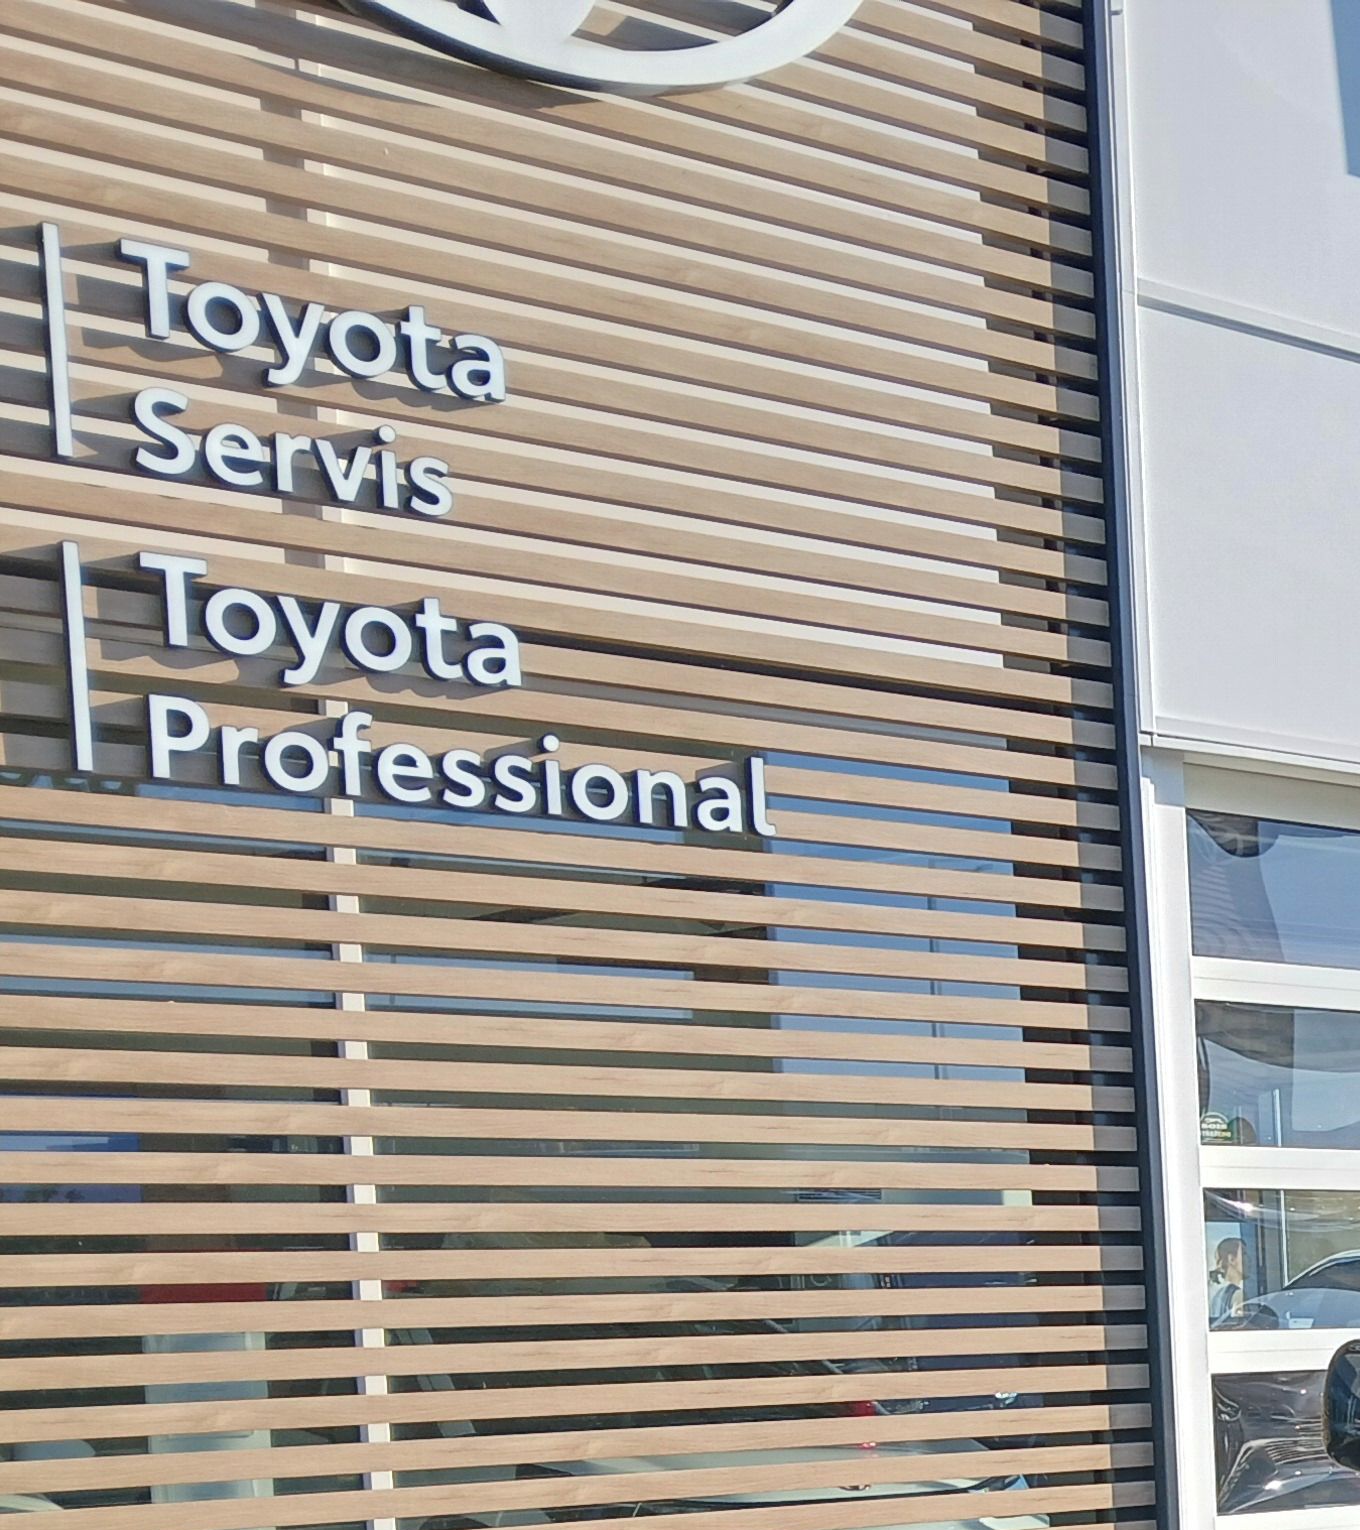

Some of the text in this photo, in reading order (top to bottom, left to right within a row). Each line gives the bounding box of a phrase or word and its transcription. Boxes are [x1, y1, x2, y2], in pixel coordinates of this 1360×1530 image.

[118, 237, 507, 403] Toyota
[133, 386, 455, 518] Servis
[138, 550, 523, 688] Toyota
[147, 692, 778, 838] Professional
